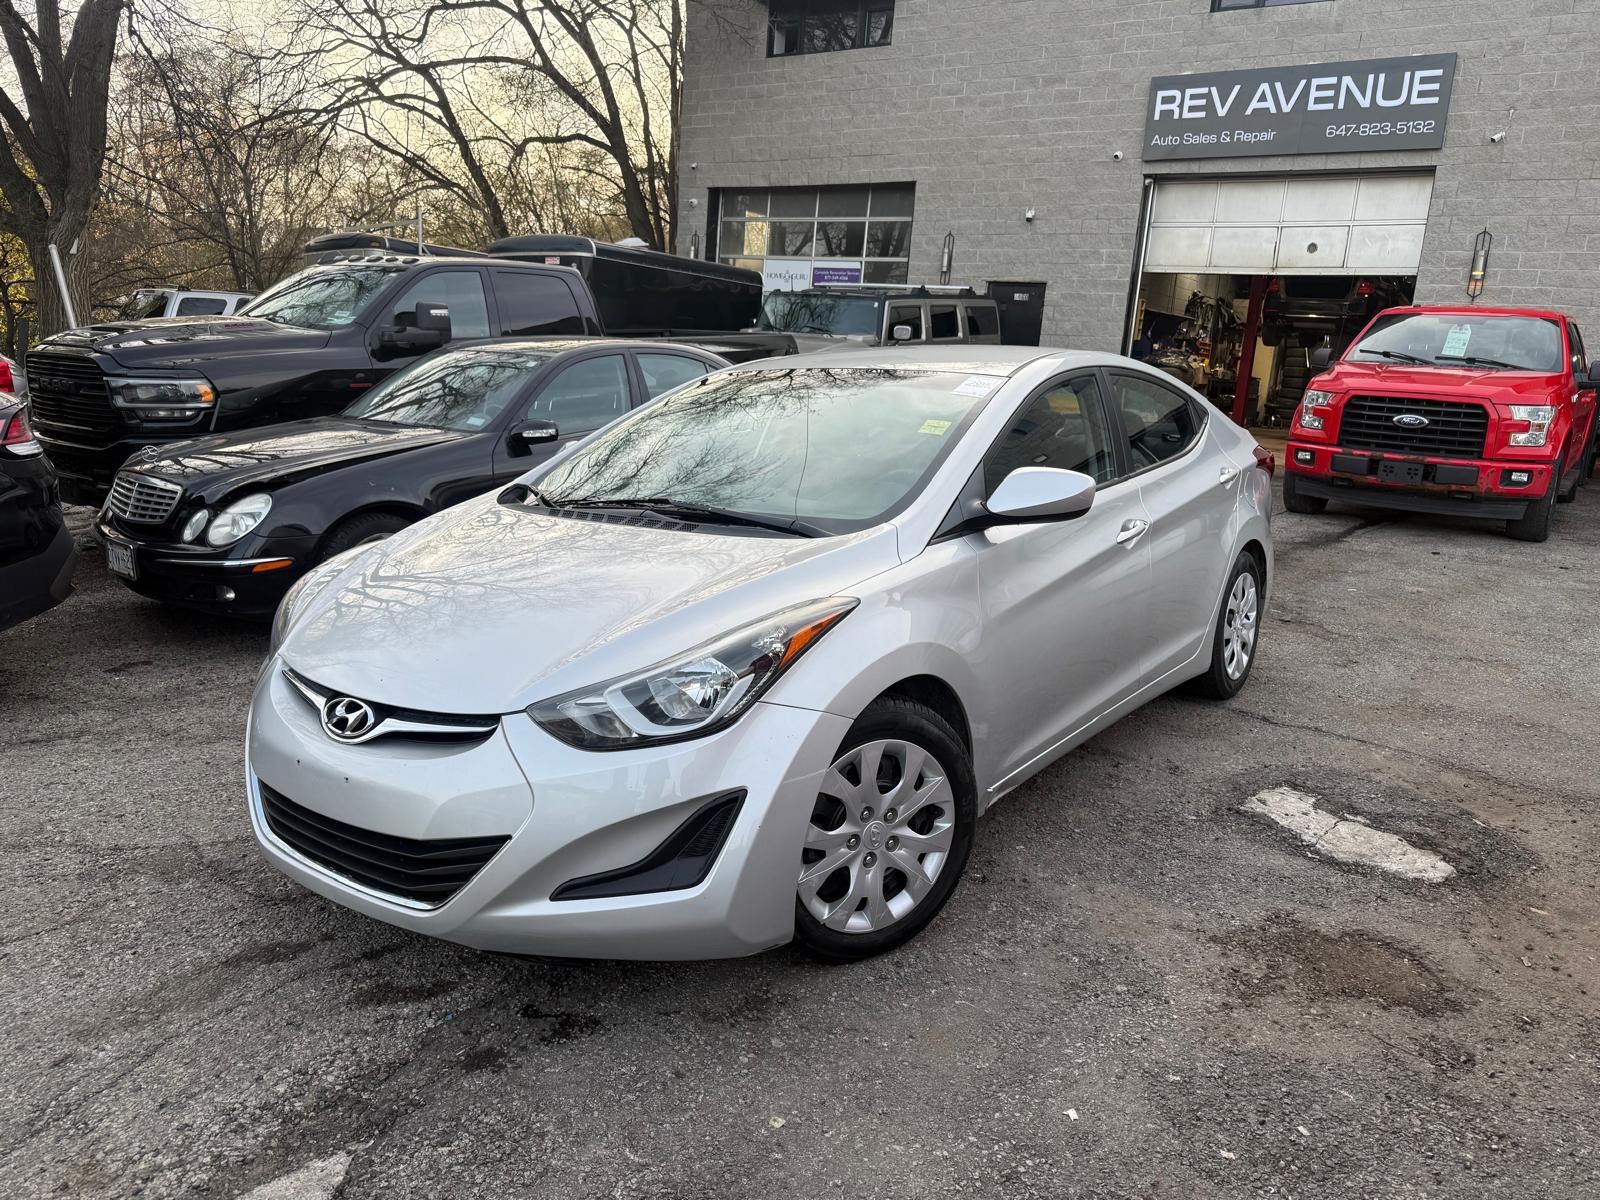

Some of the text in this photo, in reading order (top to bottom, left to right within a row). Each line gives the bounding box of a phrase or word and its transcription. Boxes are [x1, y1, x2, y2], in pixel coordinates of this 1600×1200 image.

[1154, 69, 1443, 120] REV AVENUE
[1151, 129, 1277, 146] Auto Sales & Repair
[1325, 120, 1435, 138] 647-823-5132
